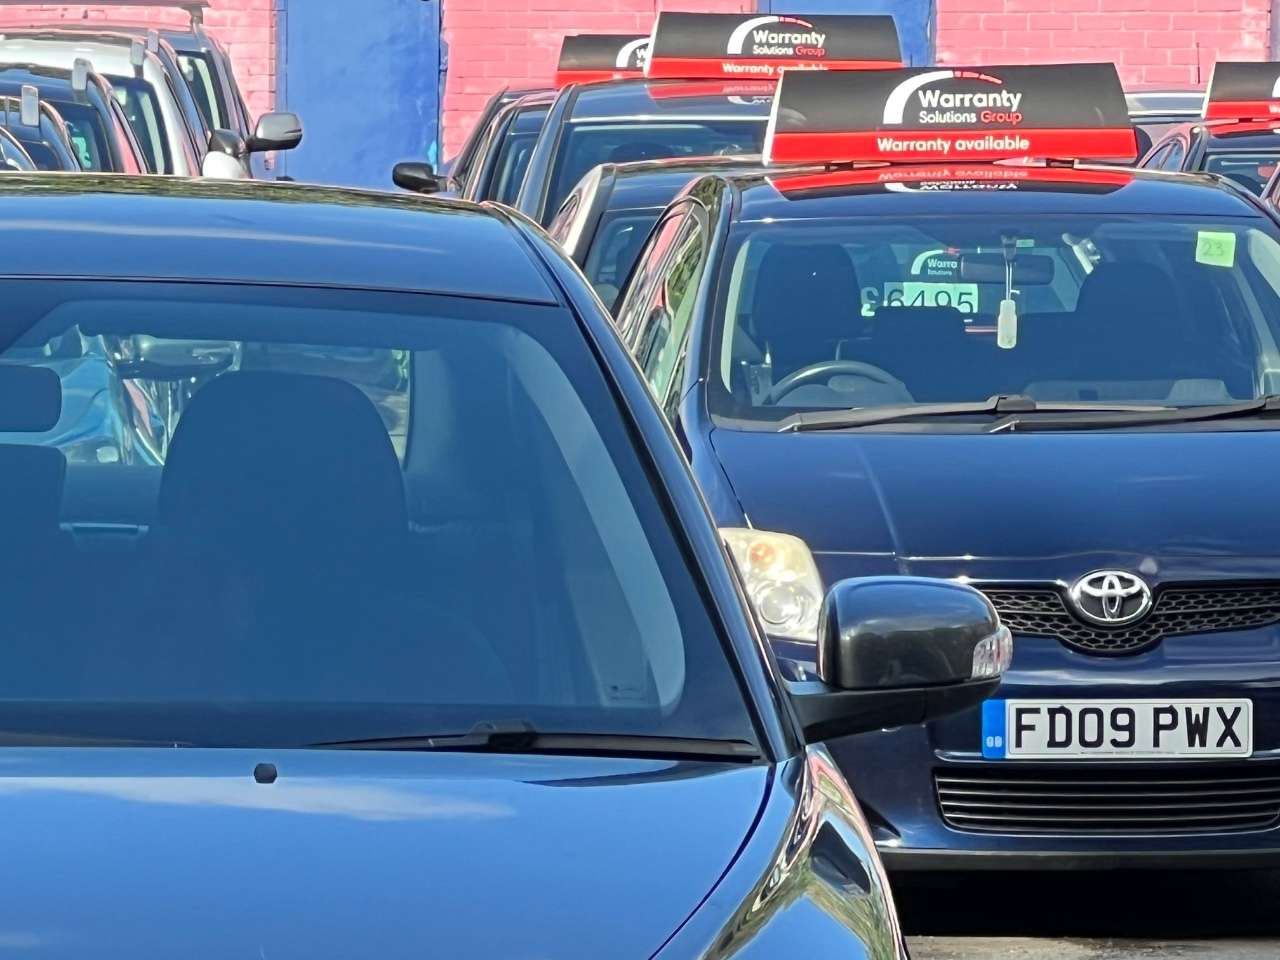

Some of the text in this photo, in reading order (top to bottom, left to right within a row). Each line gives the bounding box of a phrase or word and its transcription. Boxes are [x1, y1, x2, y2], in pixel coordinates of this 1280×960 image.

[753, 30, 826, 48] Warranty
[753, 45, 826, 56] Solutions Group
[723, 63, 774, 76] Warranty
[918, 90, 1022, 112] Warranty
[919, 111, 1022, 125] Solutions Group
[877, 136, 1030, 154] Warranty available
[1014, 704, 1242, 748] FD09 PWX
